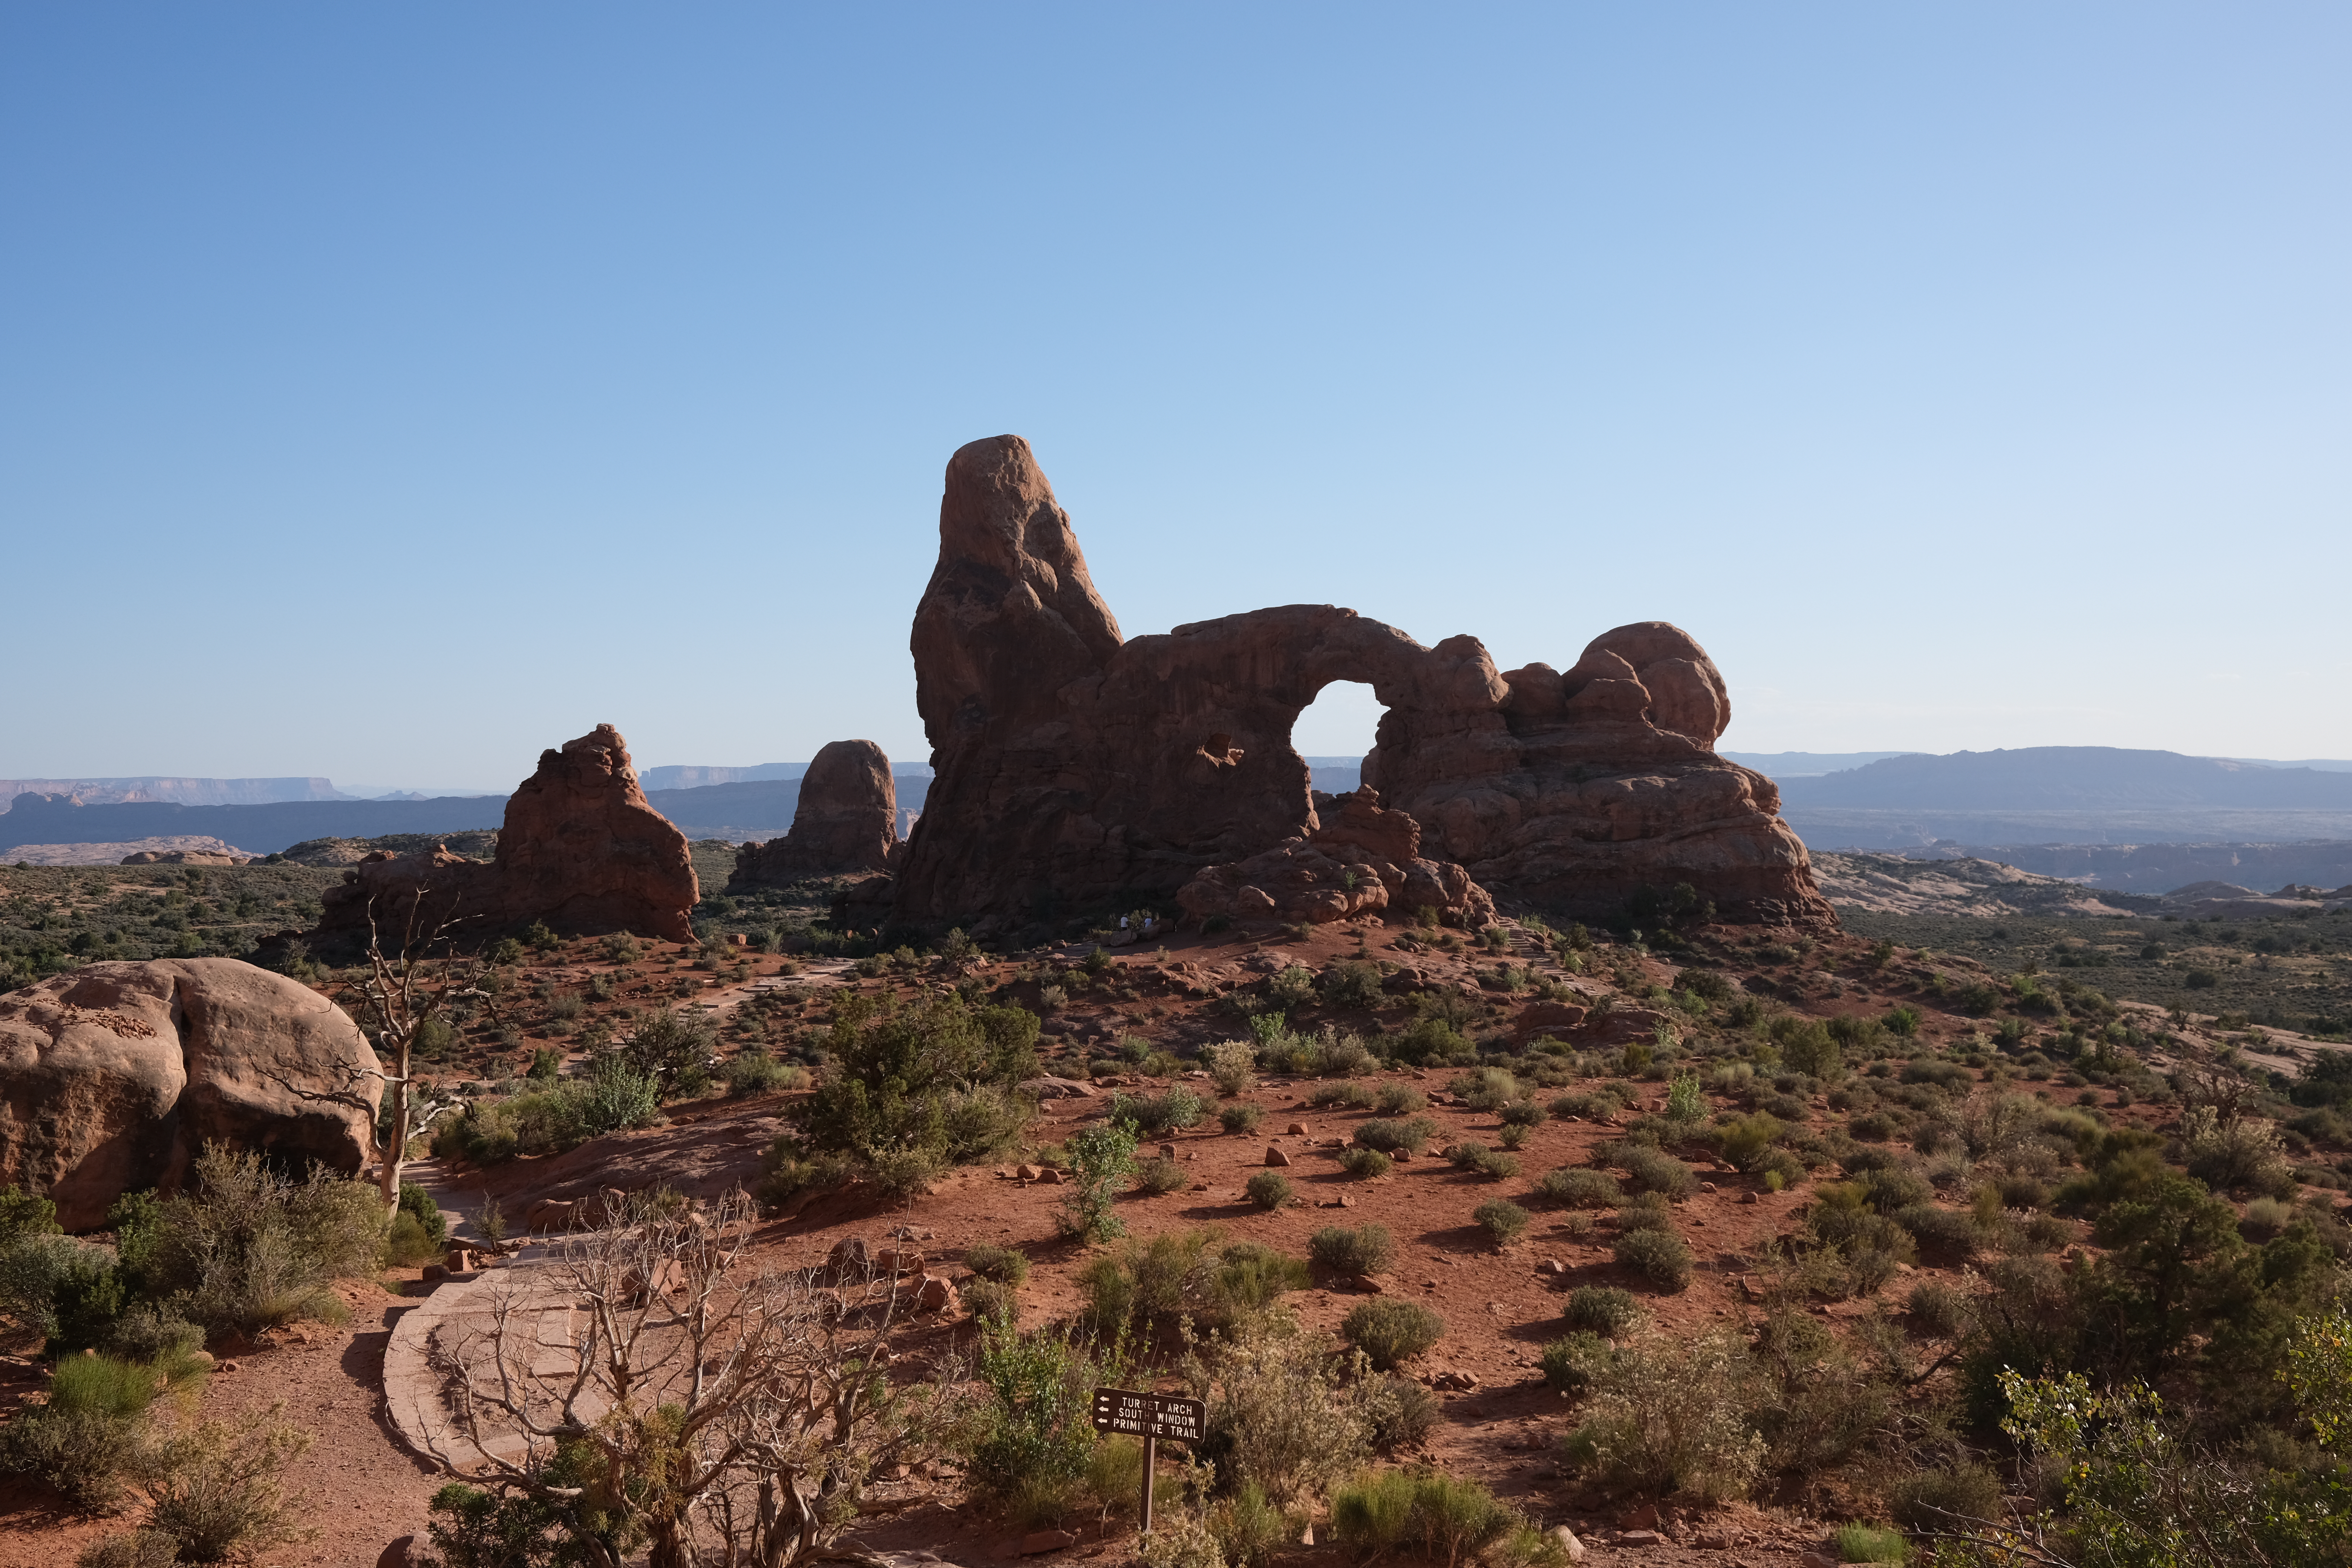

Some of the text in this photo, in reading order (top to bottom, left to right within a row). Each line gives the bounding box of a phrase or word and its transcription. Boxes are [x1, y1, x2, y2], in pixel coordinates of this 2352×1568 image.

[1122, 1397, 1192, 1415] TURRET ARCH
[1118, 1407, 1195, 1427] SOUTH WINDOW
[1113, 1418, 1199, 1439] PRIMITIVE TRAIL
